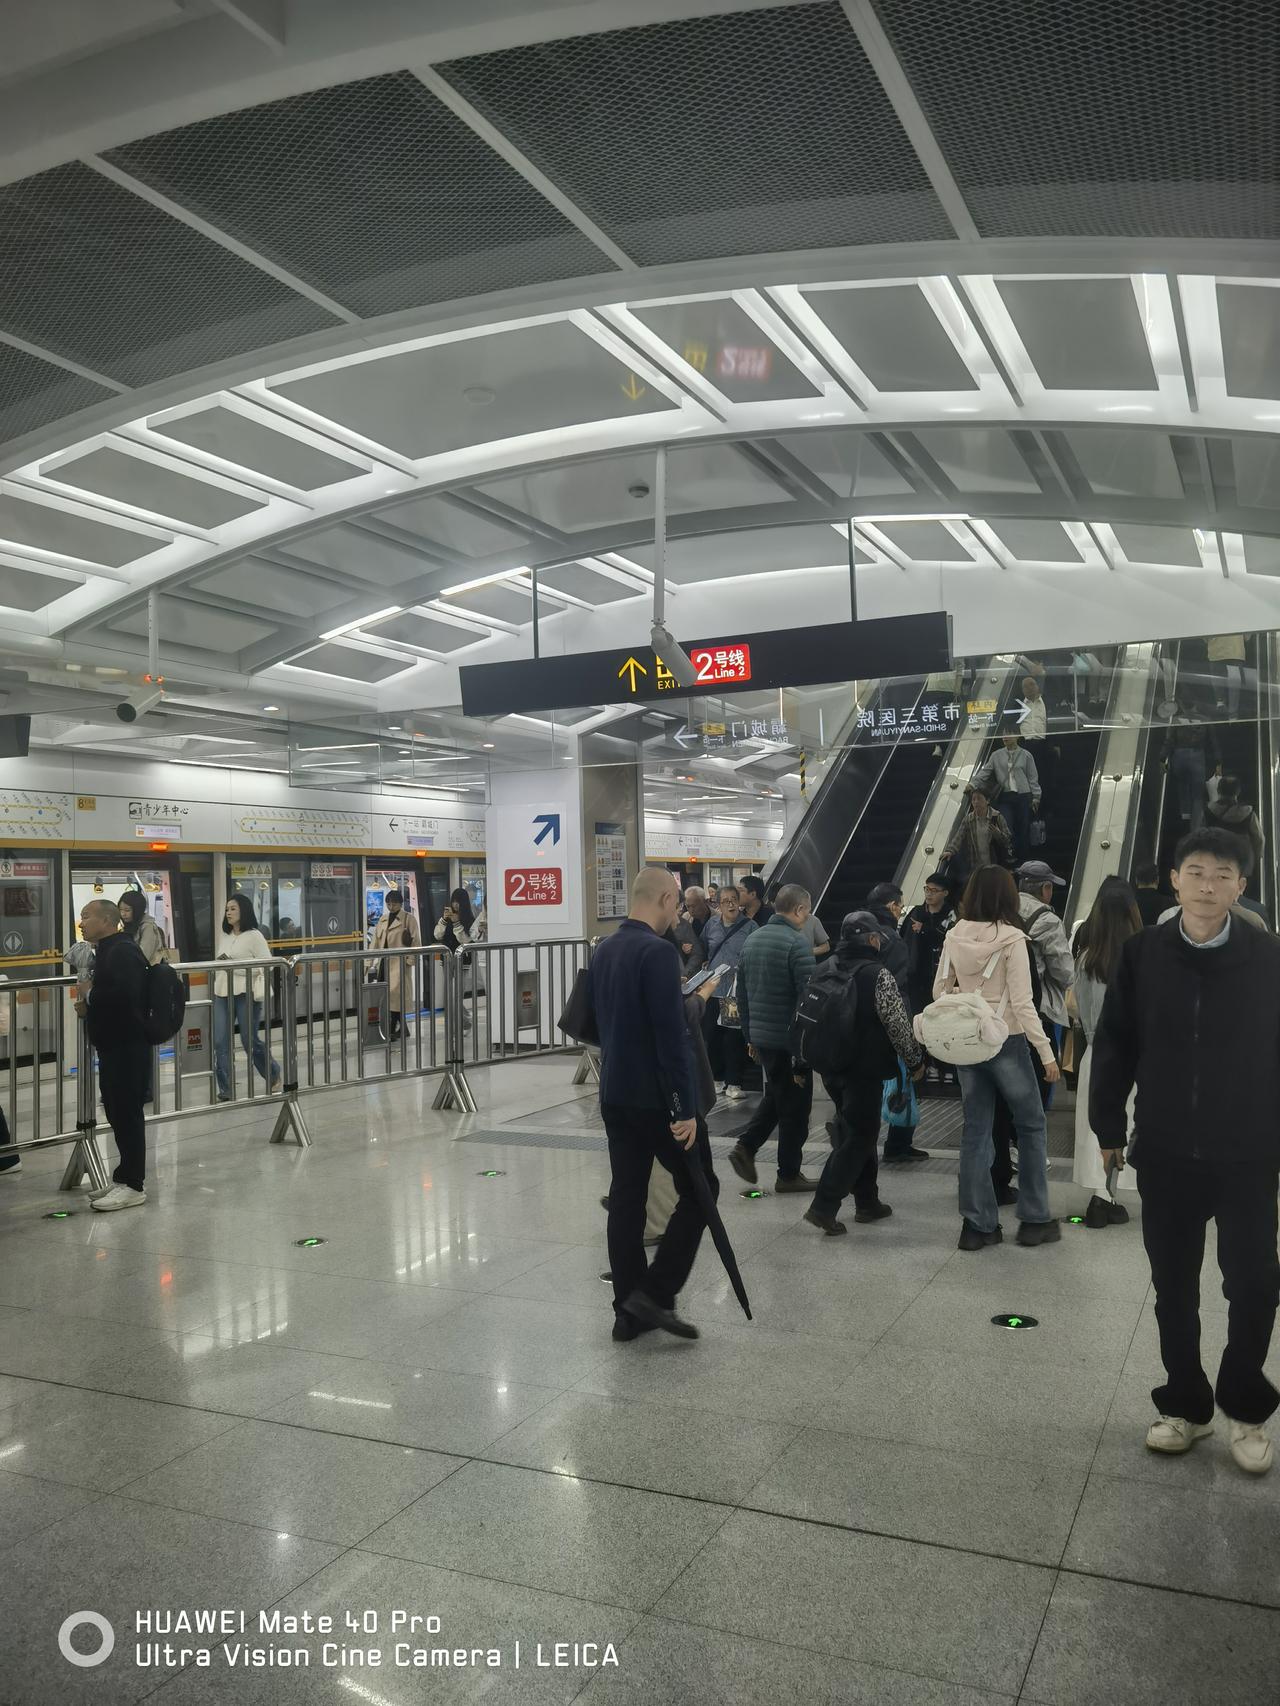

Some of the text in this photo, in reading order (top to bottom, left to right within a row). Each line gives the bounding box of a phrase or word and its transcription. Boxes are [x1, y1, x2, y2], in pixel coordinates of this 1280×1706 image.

[696, 649, 745, 680] 2号线
[714, 665, 745, 679] Line 2
[142, 803, 190, 817] 青少年中心
[510, 873, 557, 901] 2号线
[527, 890, 557, 901] Line 2
